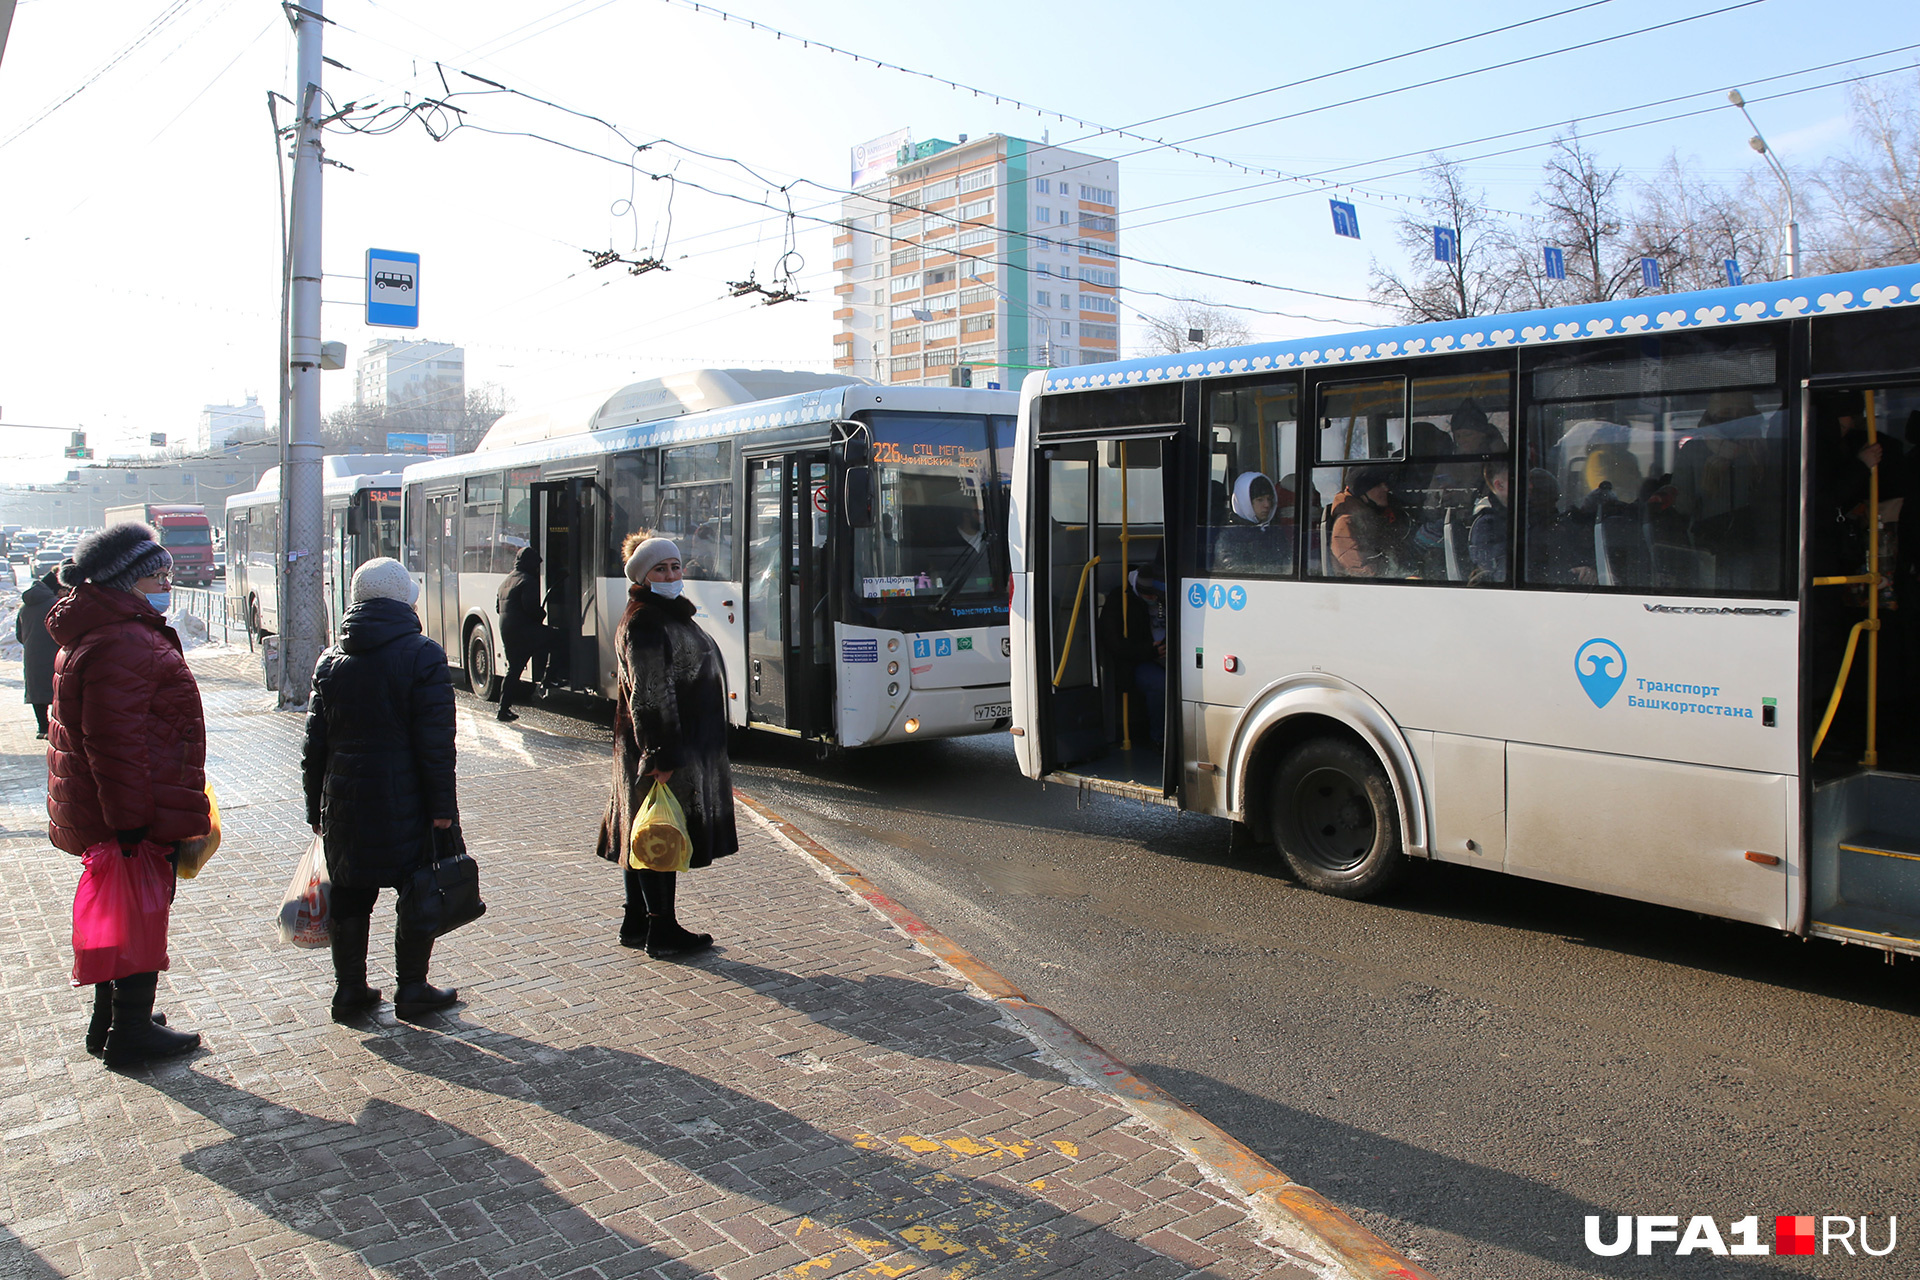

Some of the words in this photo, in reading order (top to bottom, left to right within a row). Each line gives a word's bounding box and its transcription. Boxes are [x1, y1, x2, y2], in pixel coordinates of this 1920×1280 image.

[873, 442, 900, 463] 226
[913, 443, 933, 456] СТЦ
[939, 444, 965, 456] МЕГА
[959, 456, 978, 468] ДОК
[951, 607, 992, 617] Транспорт
[993, 605, 1010, 613] Баш
[1636, 678, 1720, 698] Транспорт
[1628, 695, 1754, 719] Башкортостана
[293, 935, 329, 944] МАГНИ
